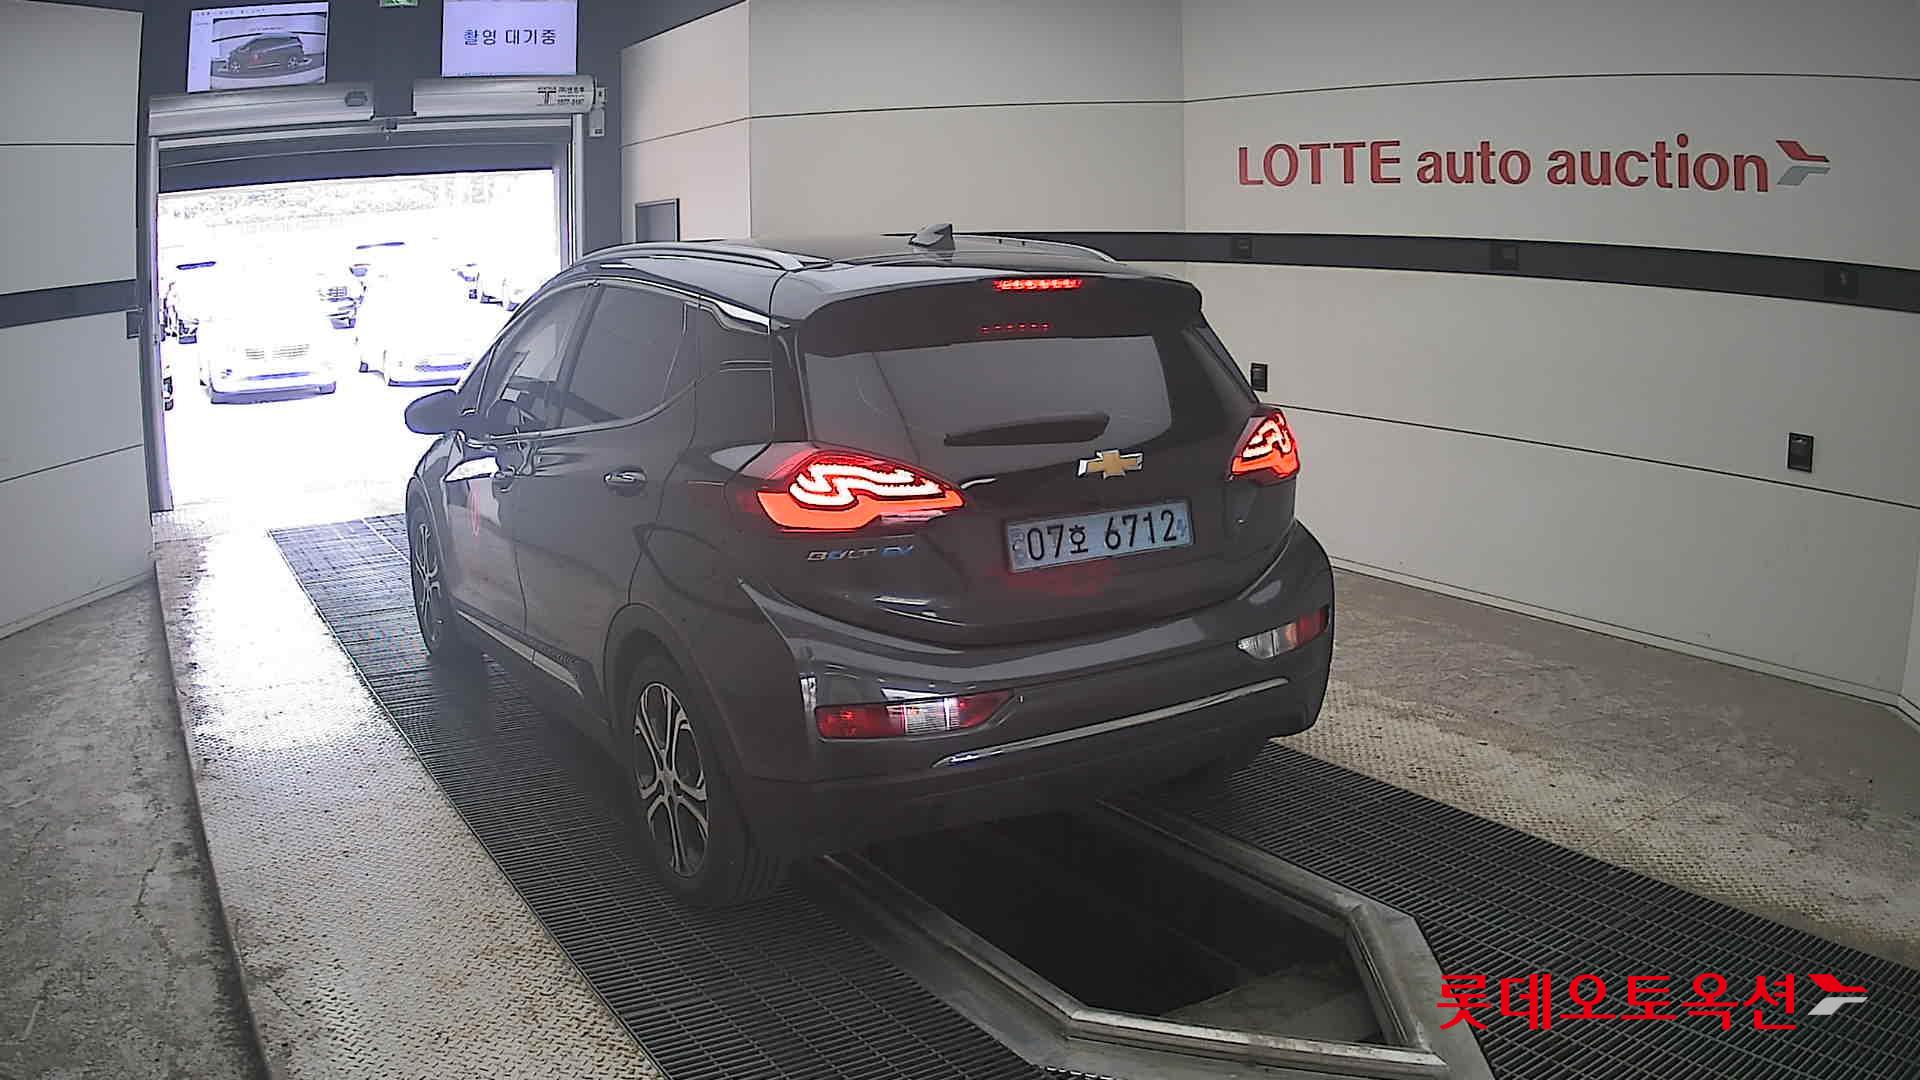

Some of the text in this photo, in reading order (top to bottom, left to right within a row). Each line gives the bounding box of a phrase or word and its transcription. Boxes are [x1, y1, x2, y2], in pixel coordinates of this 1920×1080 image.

[504, 28, 557, 46] 대기중
[1238, 133, 1769, 194] LOTTE auto auction
[1026, 509, 1178, 561] 07호 6712
[807, 547, 878, 561] BOLT
